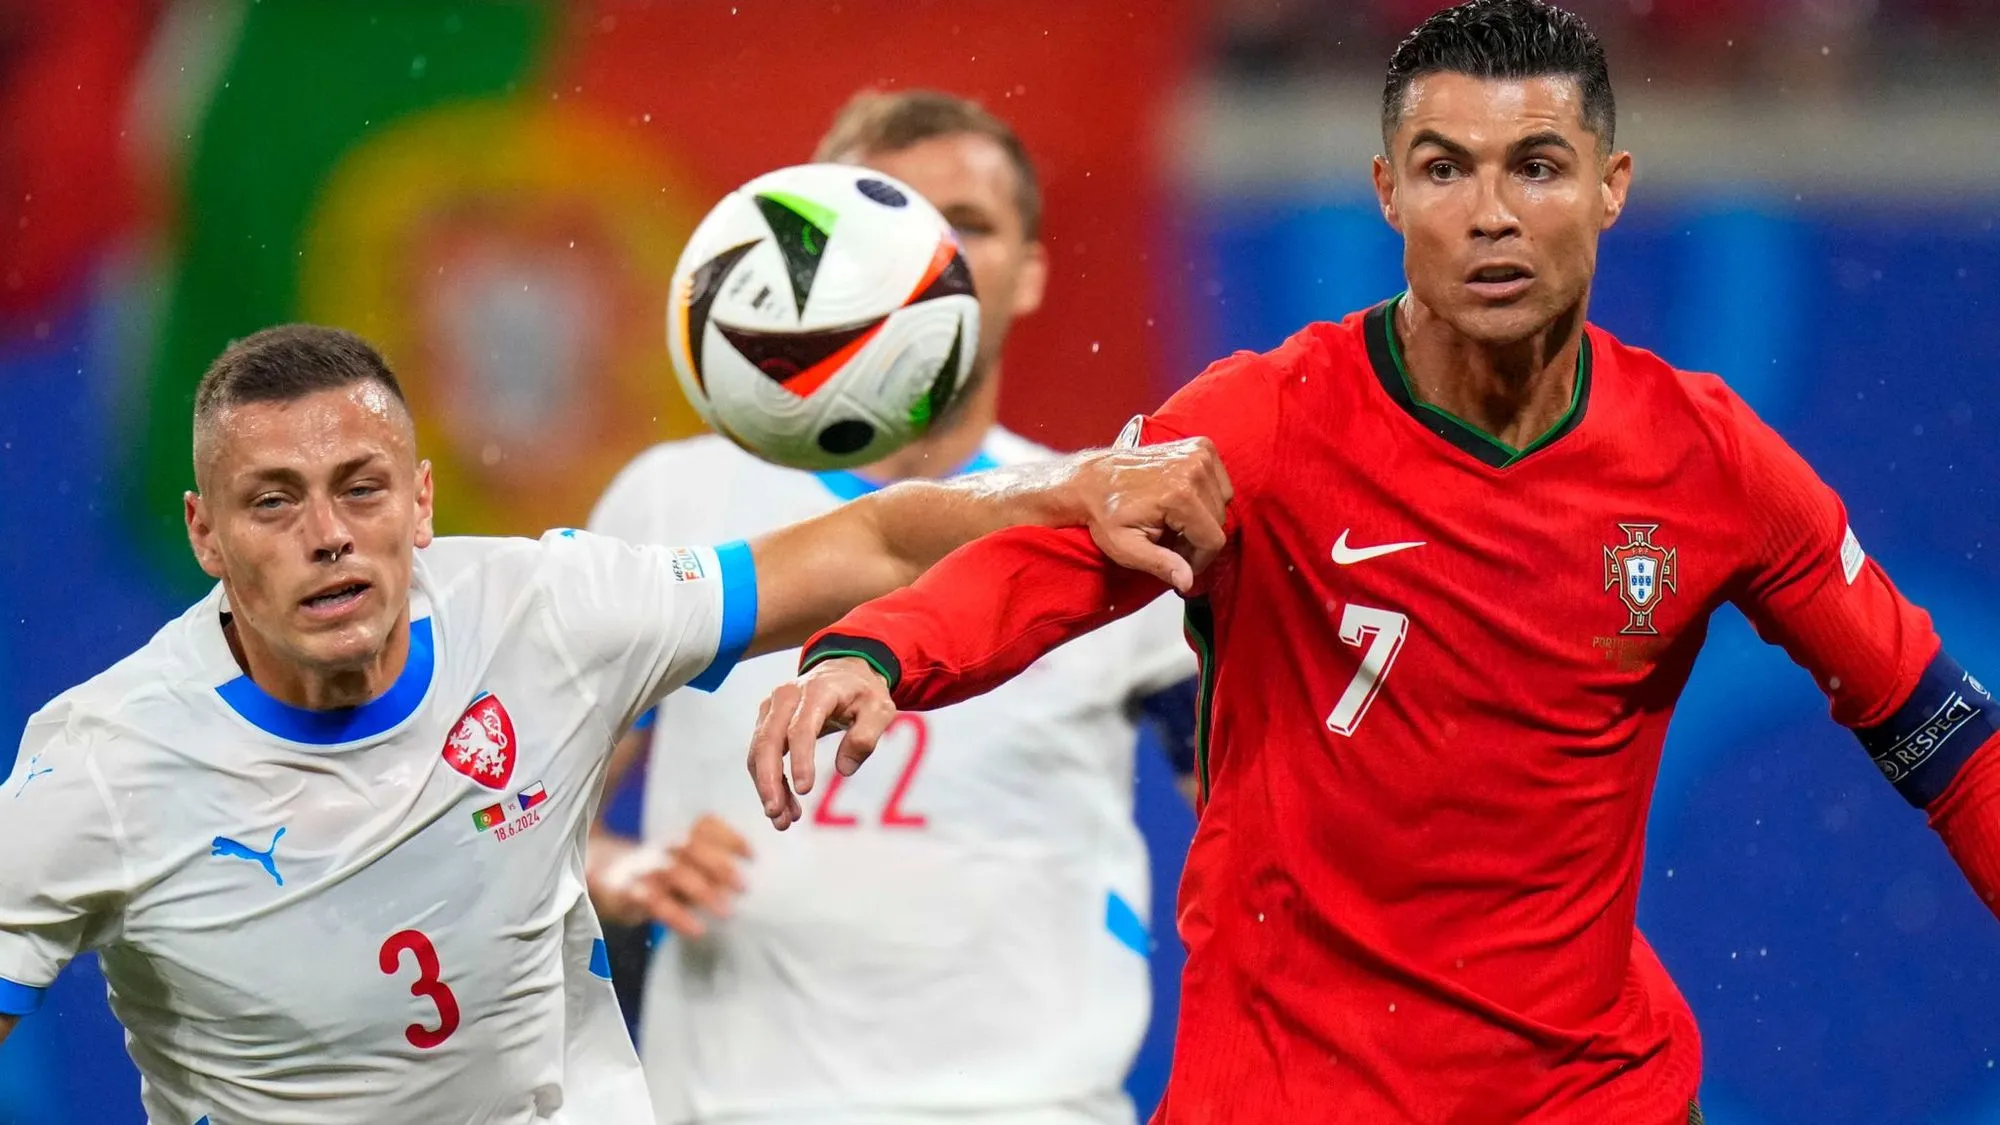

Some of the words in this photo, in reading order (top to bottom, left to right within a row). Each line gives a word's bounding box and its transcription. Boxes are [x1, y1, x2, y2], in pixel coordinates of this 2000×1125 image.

[1326, 603, 1409, 737] 7
[1896, 696, 1971, 764] RESPECT
[494, 810, 540, 842] 18.6.2024
[379, 929, 460, 1049] 3
